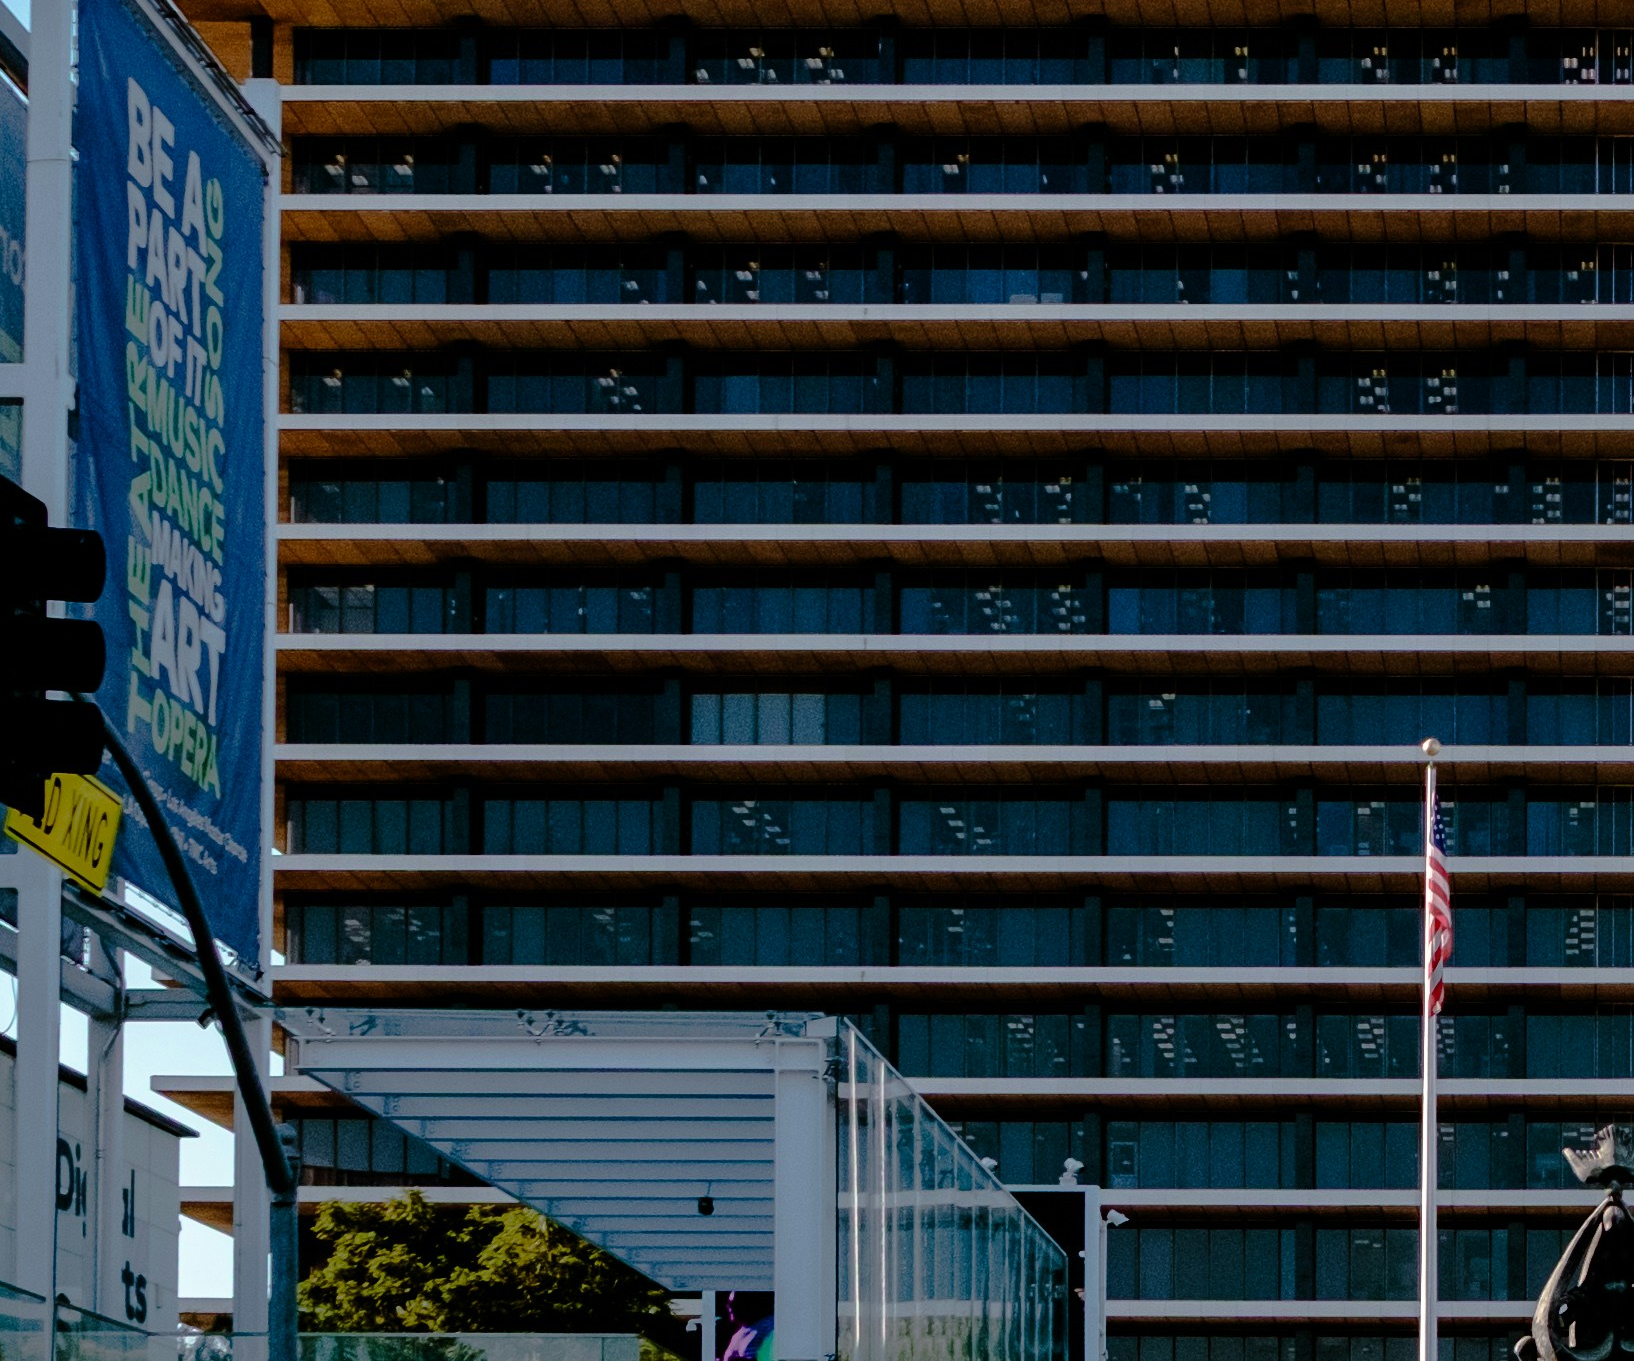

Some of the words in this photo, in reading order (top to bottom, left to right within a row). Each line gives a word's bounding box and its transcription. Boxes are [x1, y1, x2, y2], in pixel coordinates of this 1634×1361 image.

[127, 76, 174, 219] BE
[181, 150, 208, 258] A
[127, 180, 207, 338] PART
[204, 177, 224, 429] SONG
[149, 300, 183, 379] OF
[185, 335, 207, 406] IT
[147, 369, 225, 494] MUSIC
[126, 273, 152, 733] THEATRE
[150, 440, 225, 566] DANCE
[151, 510, 226, 623] MAKING
[151, 579, 225, 726] ART
[151, 688, 220, 800] OPERA
[62, 790, 108, 869] XING
